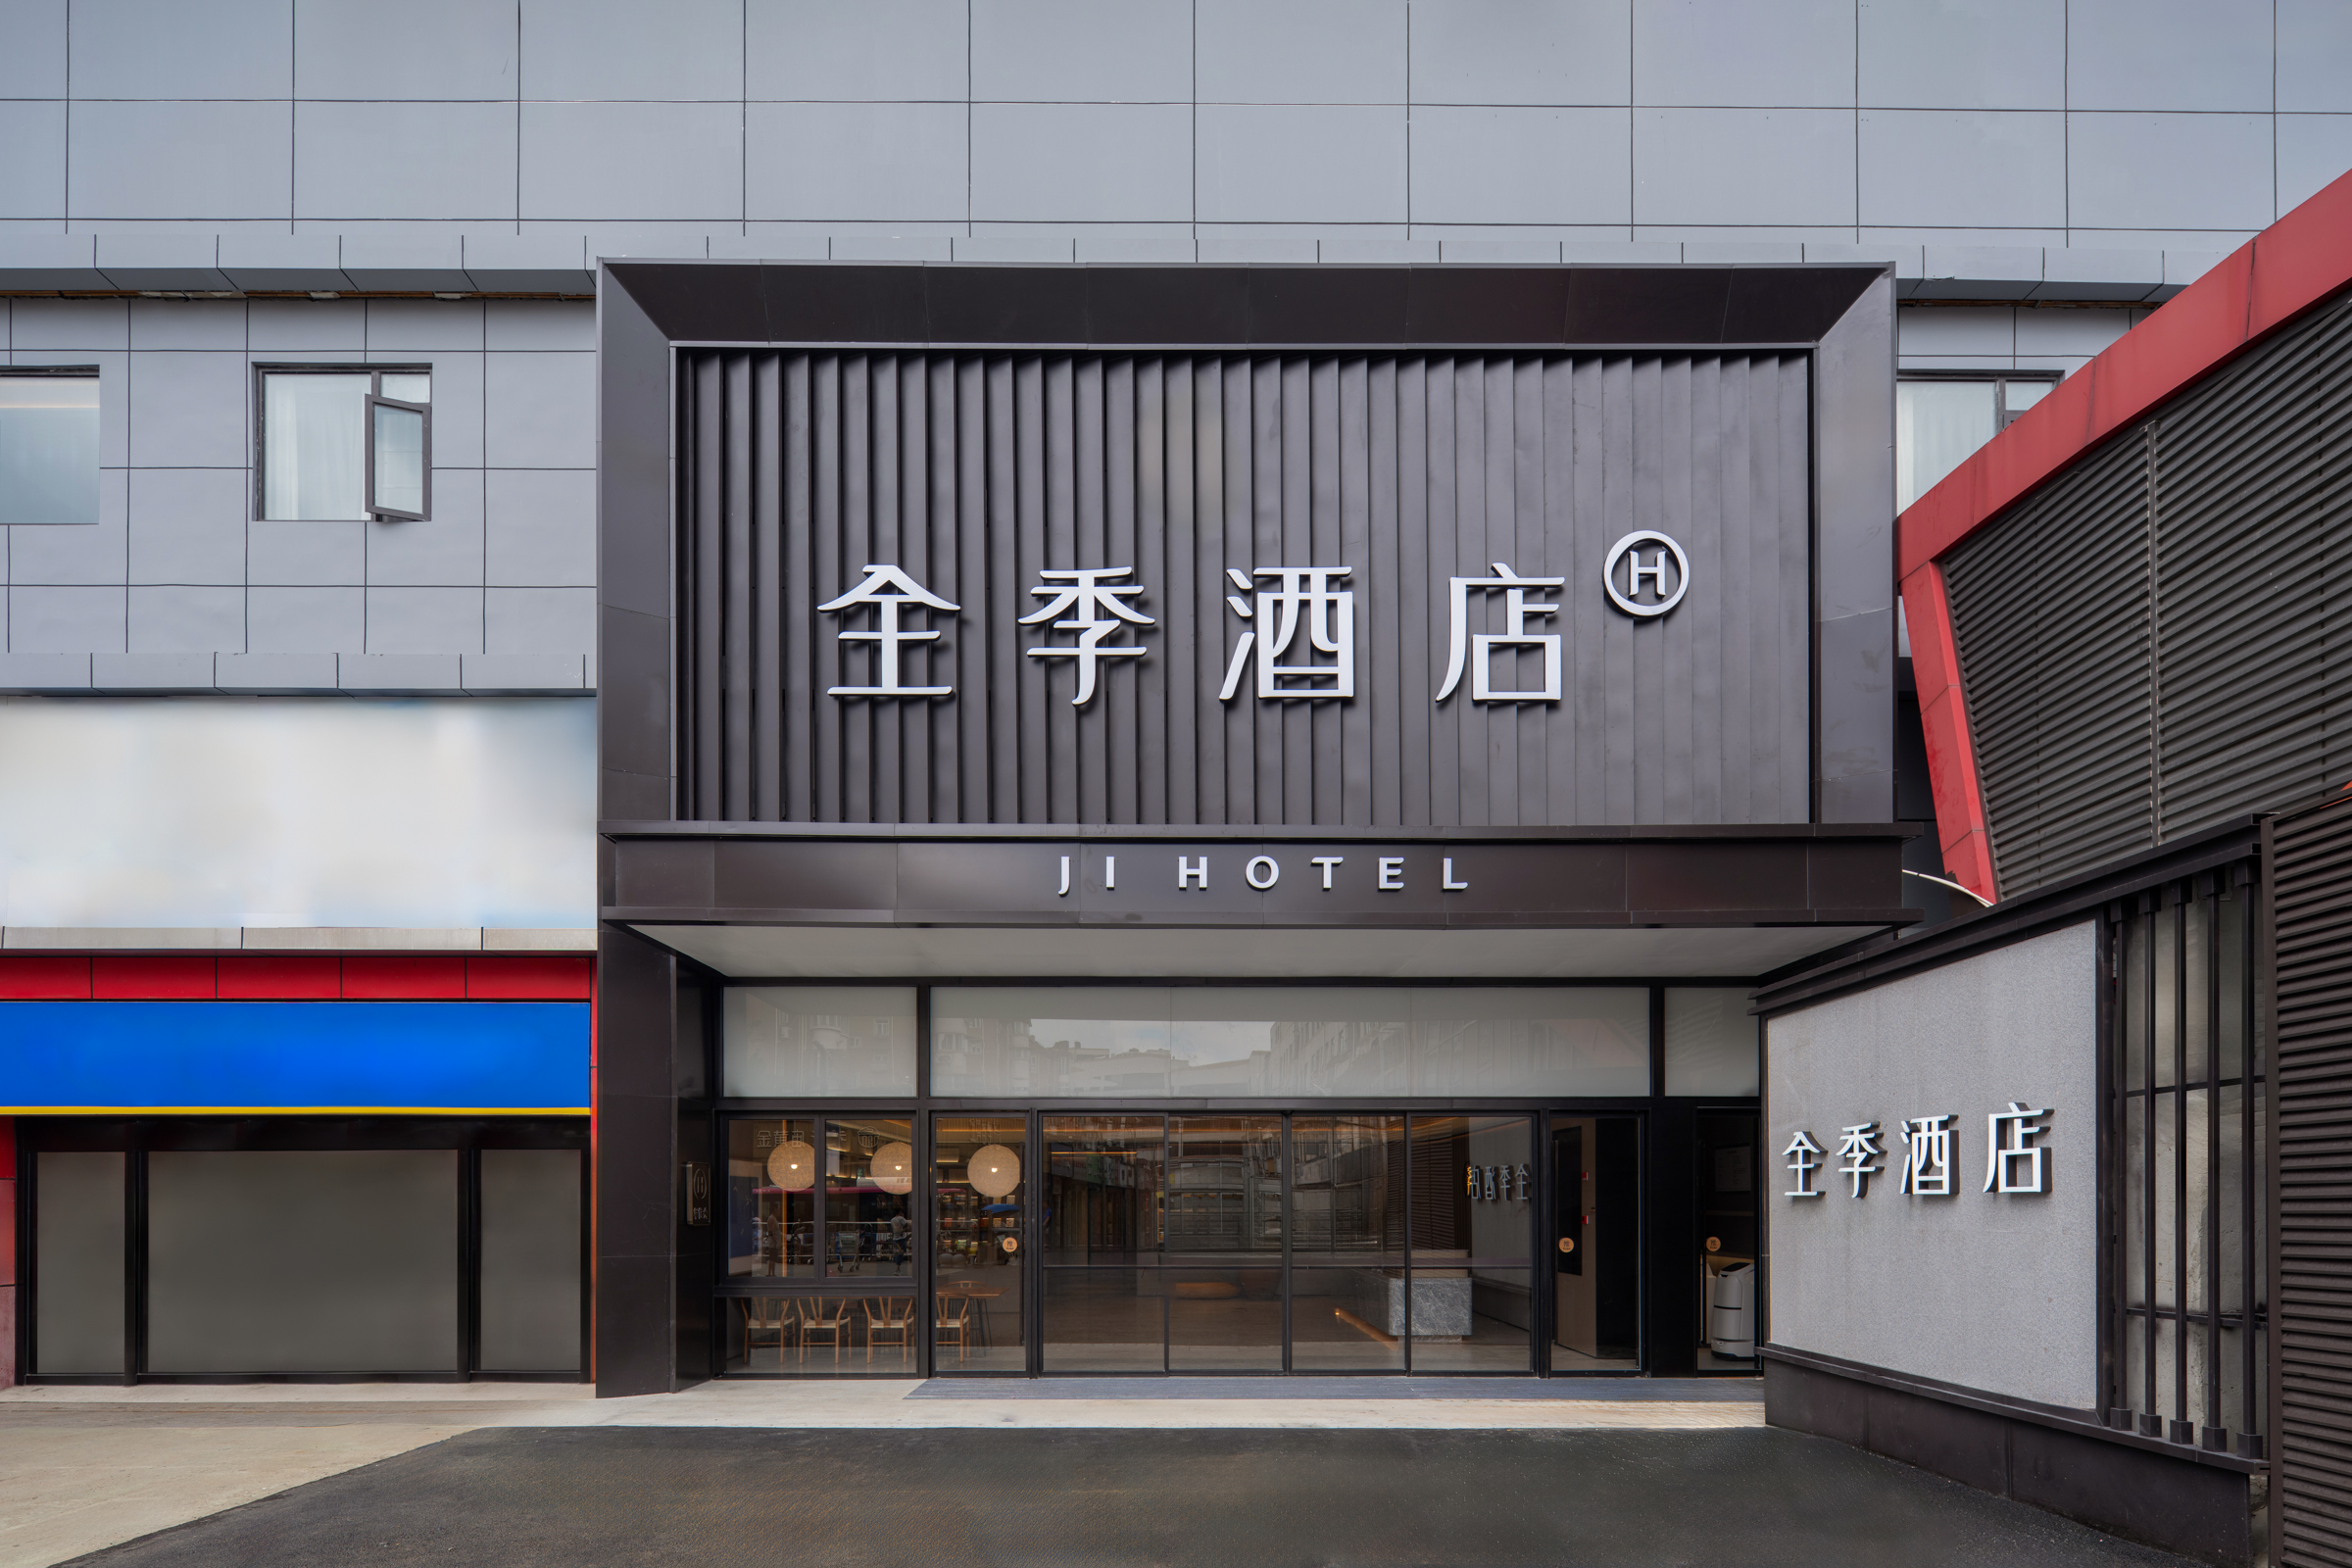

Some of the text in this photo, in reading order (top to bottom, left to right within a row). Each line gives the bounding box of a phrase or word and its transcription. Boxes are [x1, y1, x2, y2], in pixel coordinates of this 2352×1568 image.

[817, 563, 1565, 705] 全季酒店
[1058, 856, 1468, 896] JI HOTEL
[1782, 1102, 2054, 1199] 全季酒店
